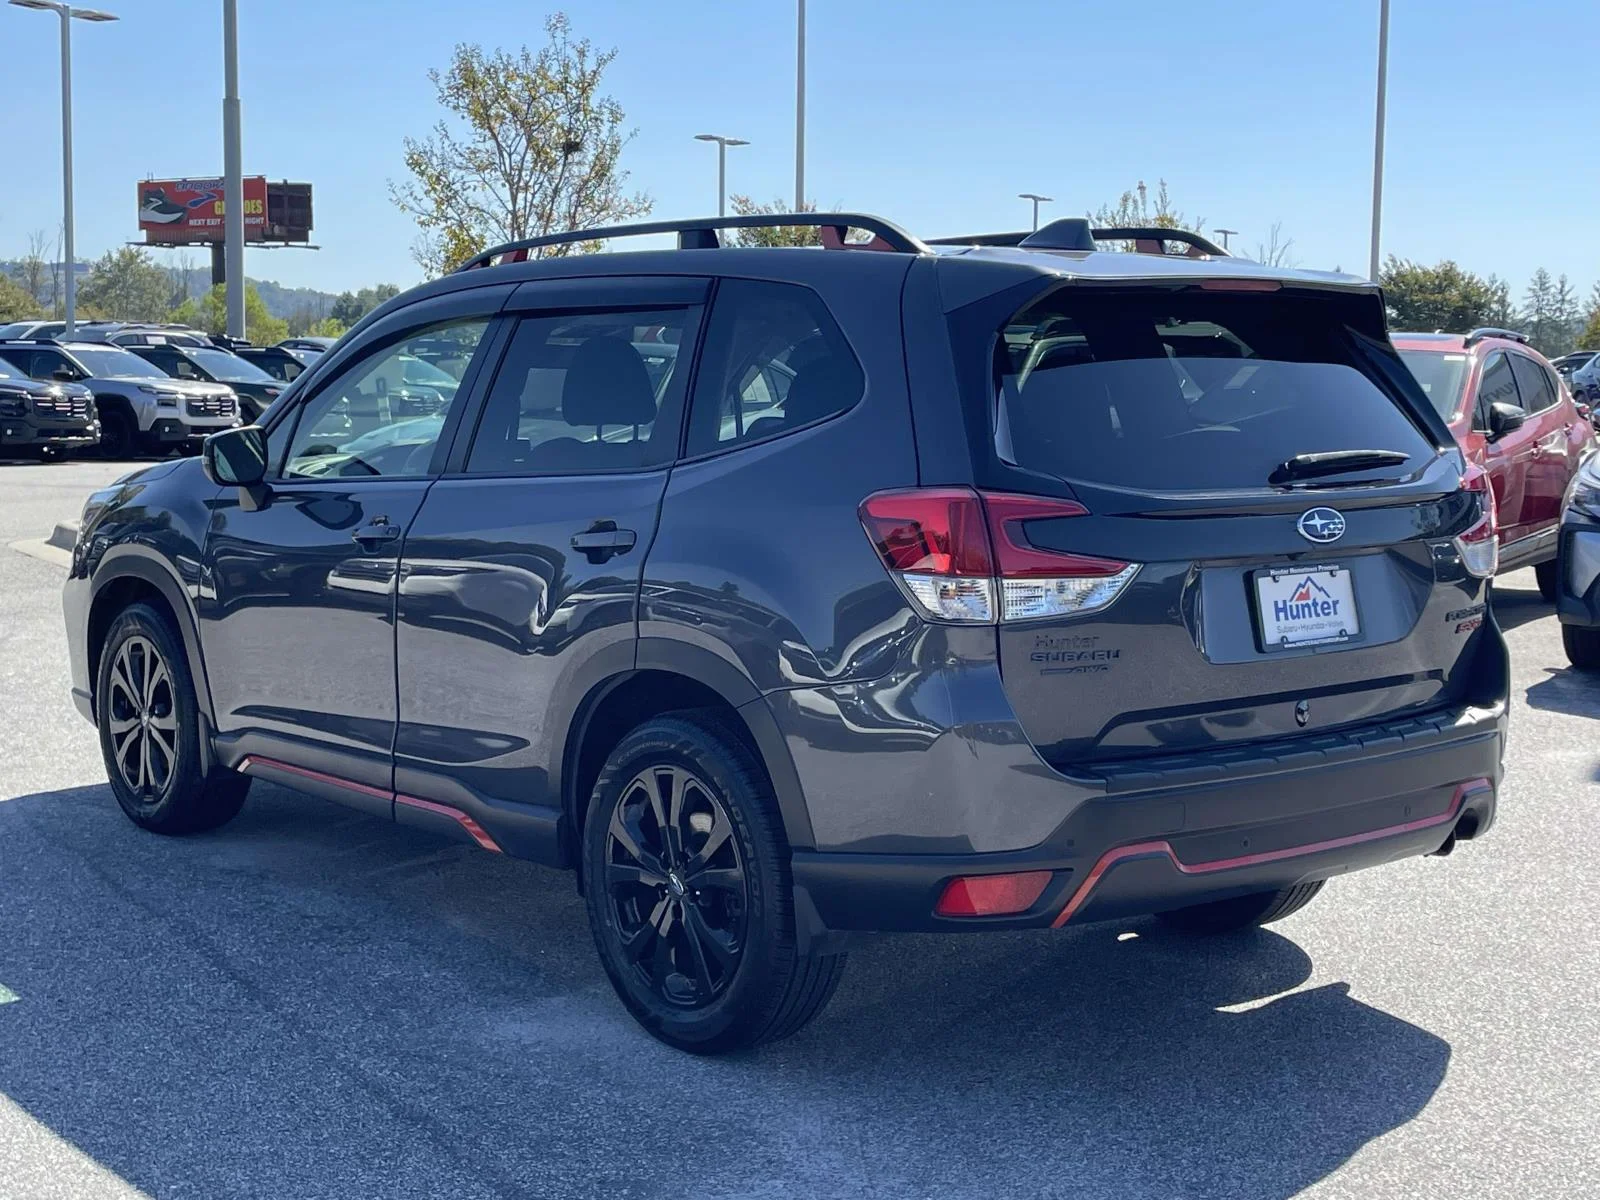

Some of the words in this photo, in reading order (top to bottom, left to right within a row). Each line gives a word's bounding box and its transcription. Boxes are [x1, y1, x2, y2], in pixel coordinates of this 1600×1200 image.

[1273, 597, 1340, 622] Hunter
[1035, 635, 1100, 649] Hunter
[1030, 649, 1121, 662] SUBARU
